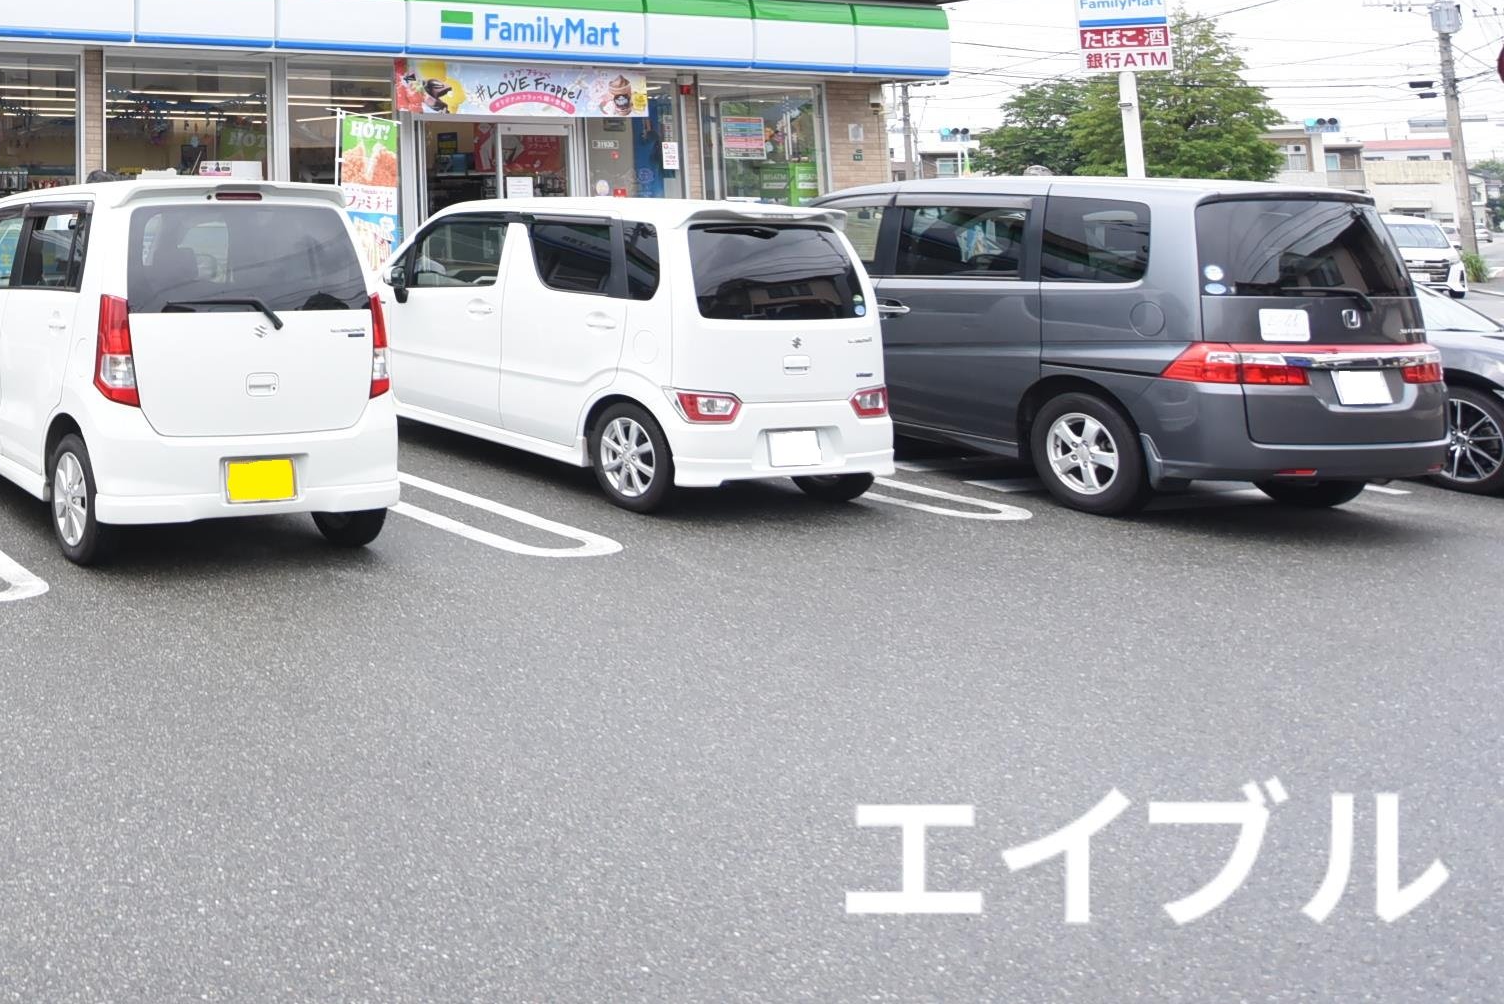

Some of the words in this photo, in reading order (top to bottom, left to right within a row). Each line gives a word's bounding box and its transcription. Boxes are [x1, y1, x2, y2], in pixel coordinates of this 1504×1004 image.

[484, 13, 620, 49] FamilyMart
[1086, 51, 1167, 69] 銀行ATM
[475, 75, 530, 102] #LOVE
[534, 77, 582, 104] Frappe!
[350, 120, 391, 141] HOT!
[346, 196, 393, 213] ファミチキ
